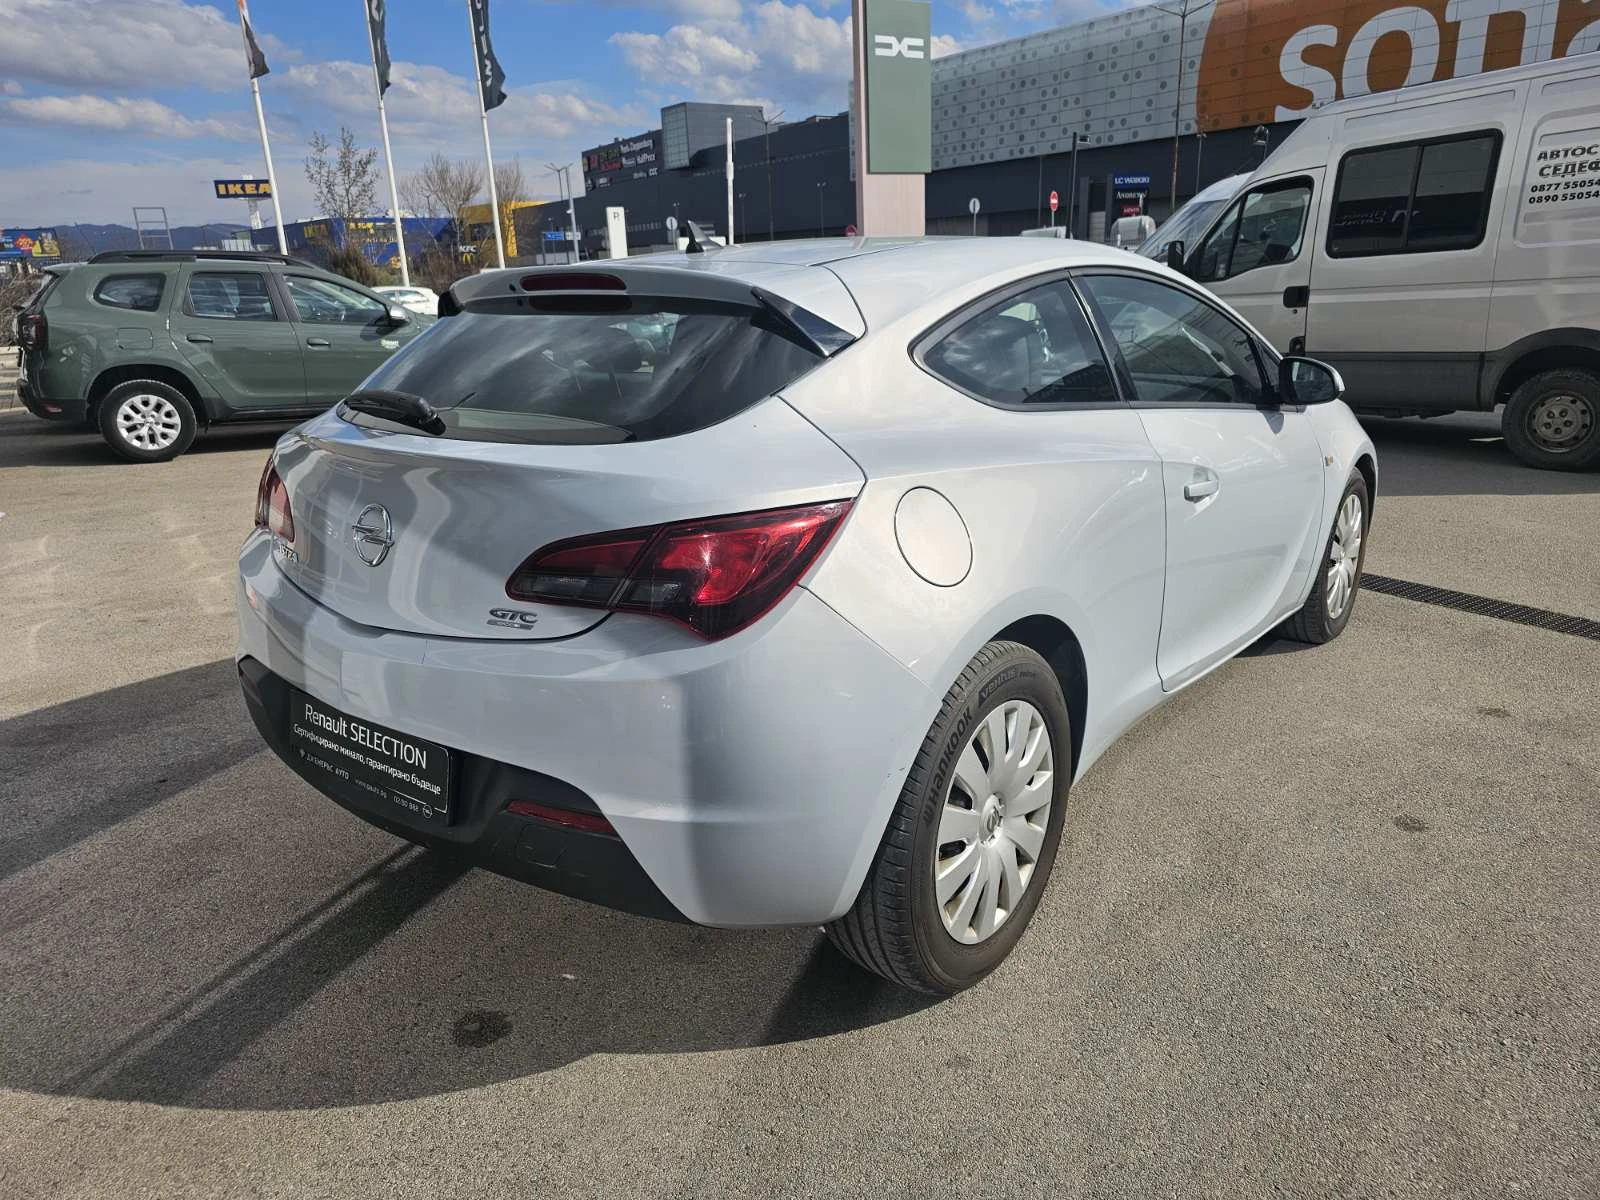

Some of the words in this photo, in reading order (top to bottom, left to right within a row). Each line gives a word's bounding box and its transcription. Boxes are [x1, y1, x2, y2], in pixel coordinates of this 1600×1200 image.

[217, 183, 271, 195] IKEA
[1530, 182, 1561, 193] 0877
[1528, 194, 1559, 204] 0890
[489, 607, 538, 624] GTC
[305, 703, 348, 738] Renault
[350, 722, 427, 770] SELECTION
[293, 723, 340, 752] Сертифицирано
[365, 757, 411, 783] гарантирано
[411, 773, 441, 795] бъдеще
